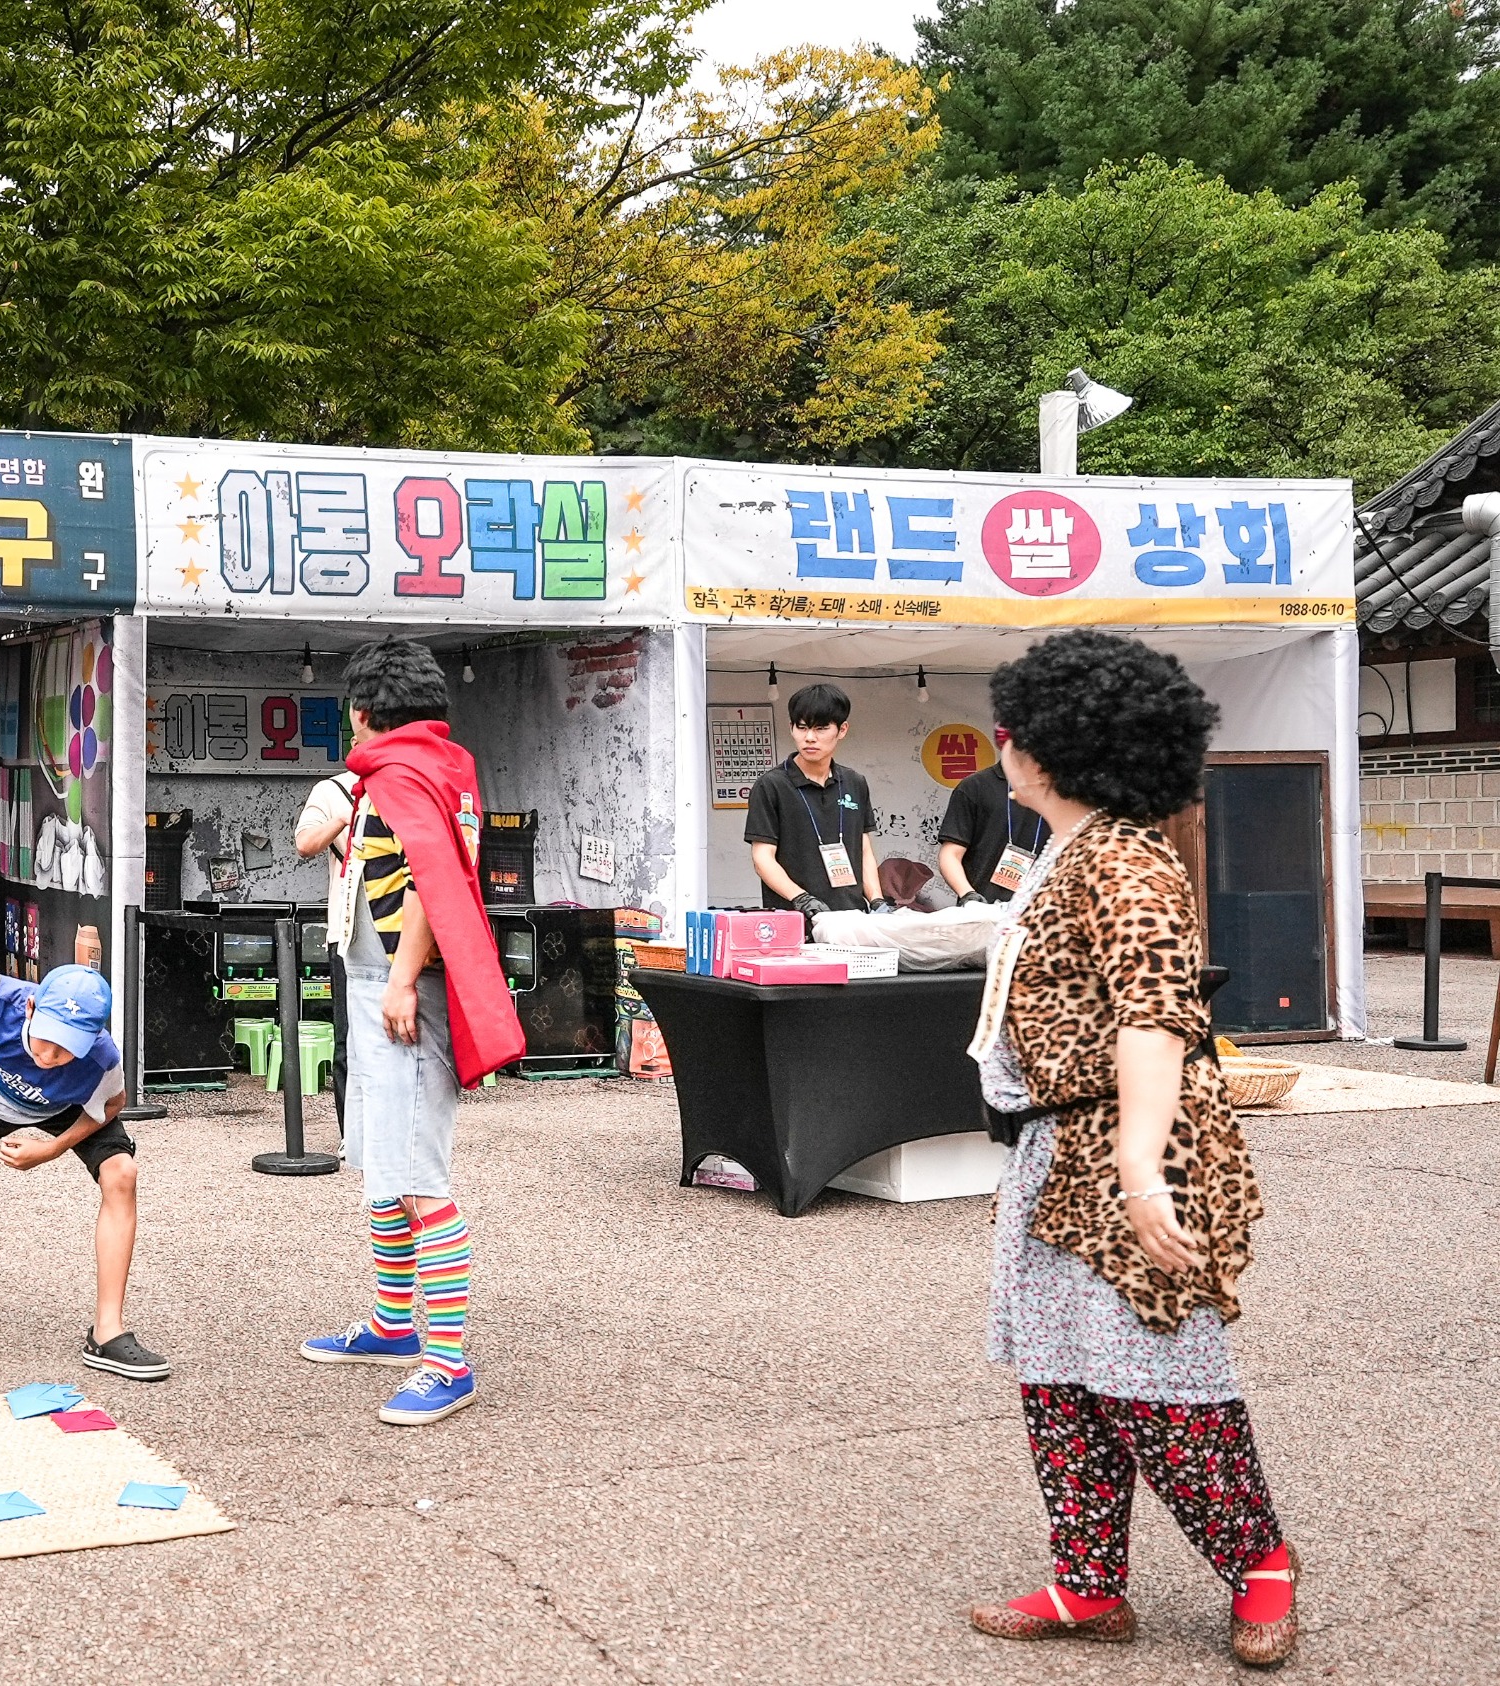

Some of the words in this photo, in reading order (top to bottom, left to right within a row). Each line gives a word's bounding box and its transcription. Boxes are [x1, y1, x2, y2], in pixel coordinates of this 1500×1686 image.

[218, 469, 370, 596] 아롱
[393, 475, 606, 600] 오락실
[785, 489, 964, 582] 랜드
[1005, 507, 1074, 579] 쌀
[1126, 500, 1292, 586] 상회
[693, 592, 719, 609] 잡곡
[731, 594, 756, 610] 고추
[819, 598, 846, 613] 도매
[856, 599, 882, 615] 소매
[894, 599, 941, 616] 신속배달
[165, 694, 248, 760] 아롱
[936, 733, 978, 779] 쌀
[717, 789, 737, 798] 랜드
[831, 867, 850, 878] STAFF
[999, 867, 1022, 882] STAFF
